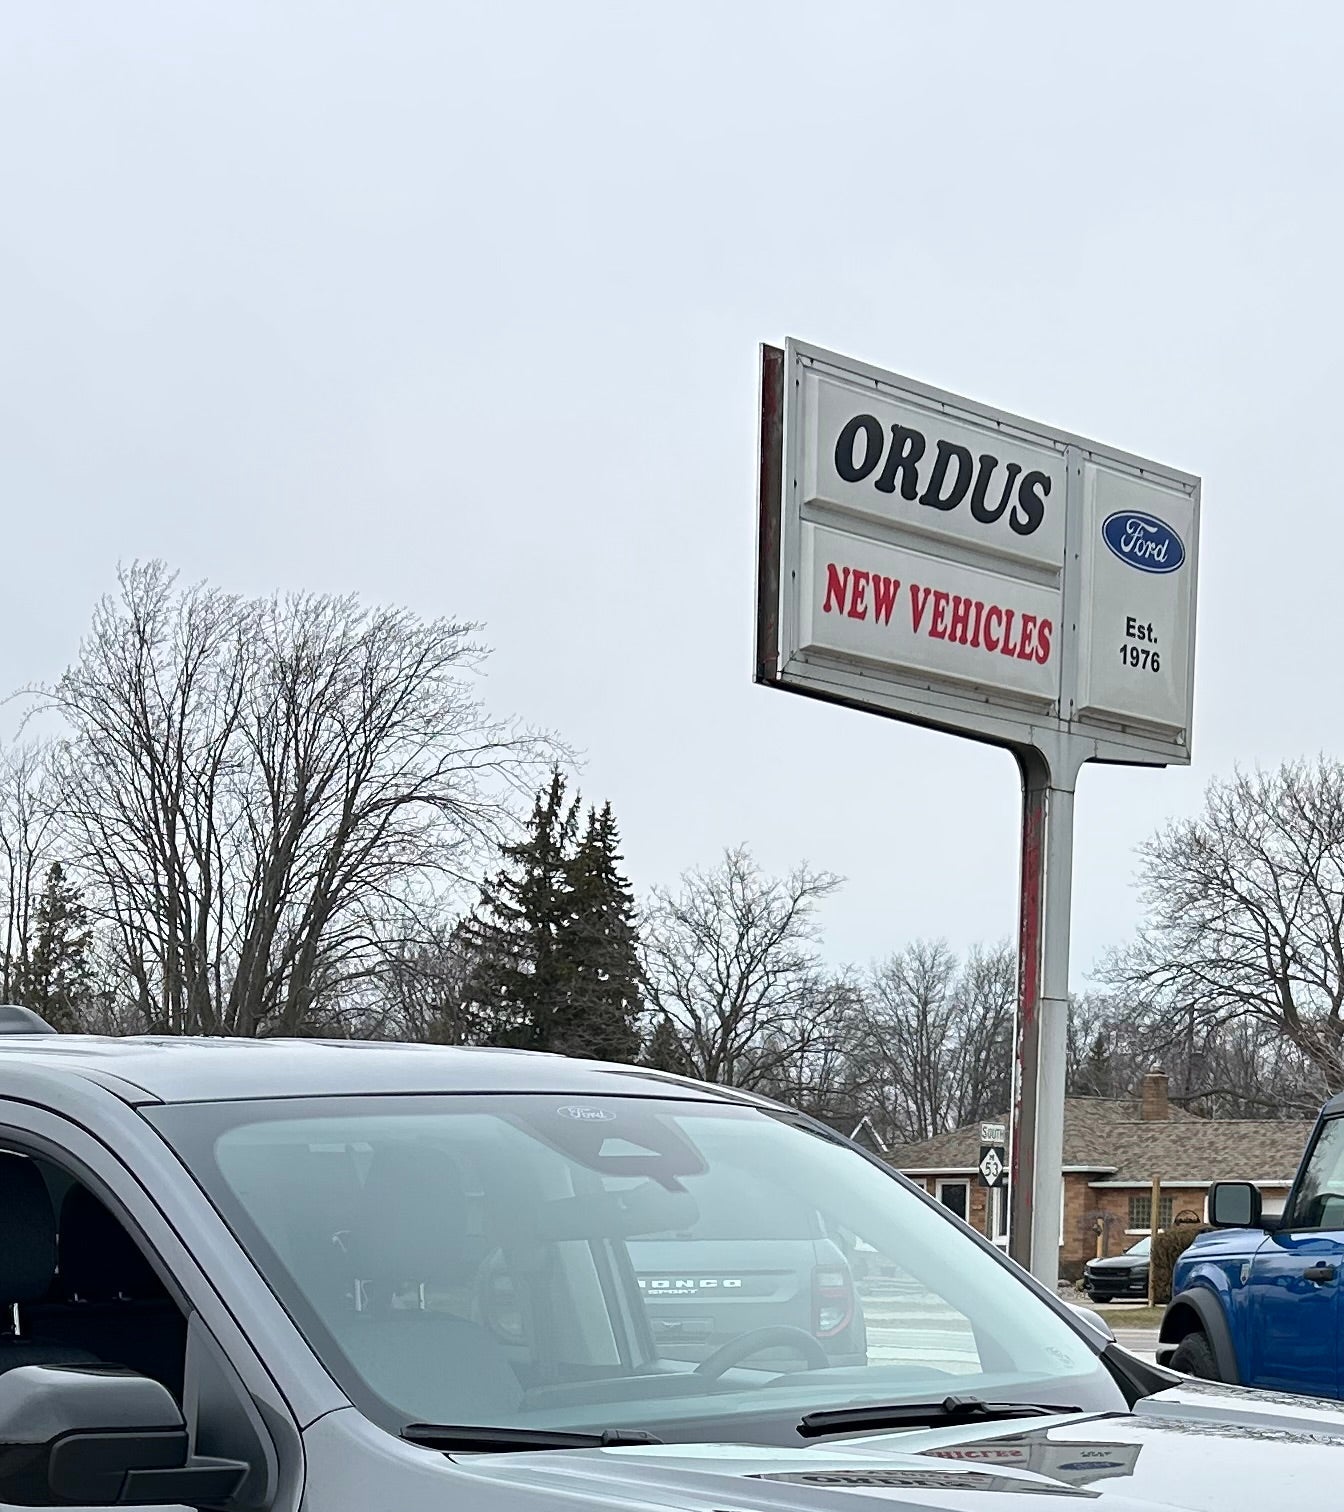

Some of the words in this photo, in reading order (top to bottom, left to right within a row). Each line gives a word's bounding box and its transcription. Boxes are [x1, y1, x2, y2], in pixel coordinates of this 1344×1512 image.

[834, 413, 1052, 536] ORDUS
[1120, 517, 1169, 564] Ford
[822, 562, 901, 628] NEW
[909, 583, 1053, 666] VEHICLES
[1124, 615, 1159, 645] Est.
[1118, 644, 1161, 674] 1976
[984, 1161, 999, 1178] 53
[637, 1279, 742, 1289] ONCO
